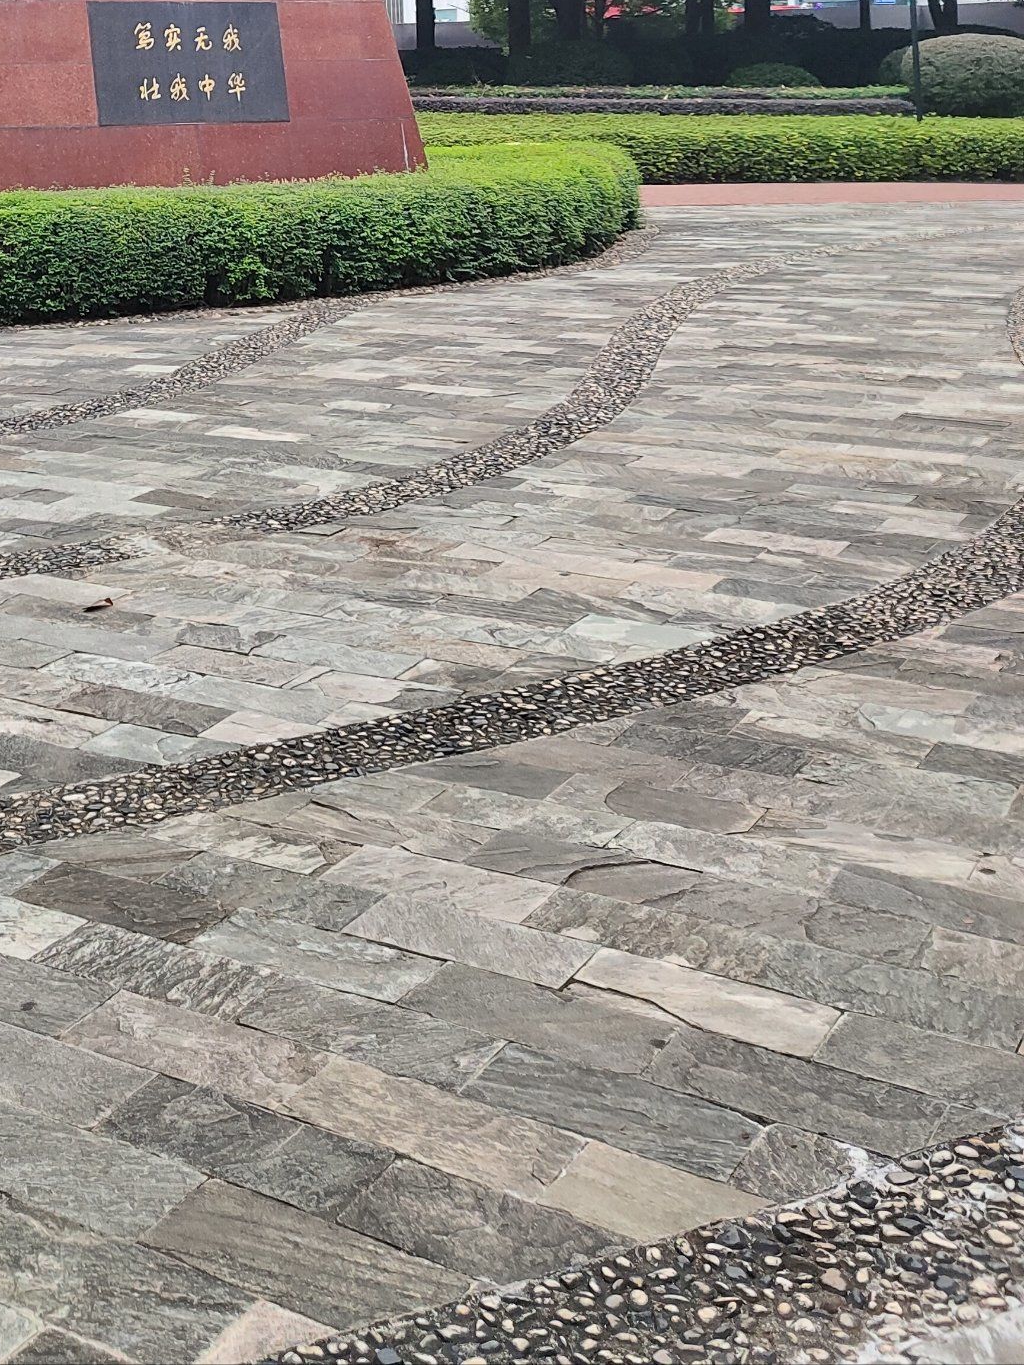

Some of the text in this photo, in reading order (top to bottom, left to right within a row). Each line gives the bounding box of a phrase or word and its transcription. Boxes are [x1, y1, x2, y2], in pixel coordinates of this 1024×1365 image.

[134, 22, 242, 52] 笃实无我
[139, 72, 246, 102] 壮我中华
